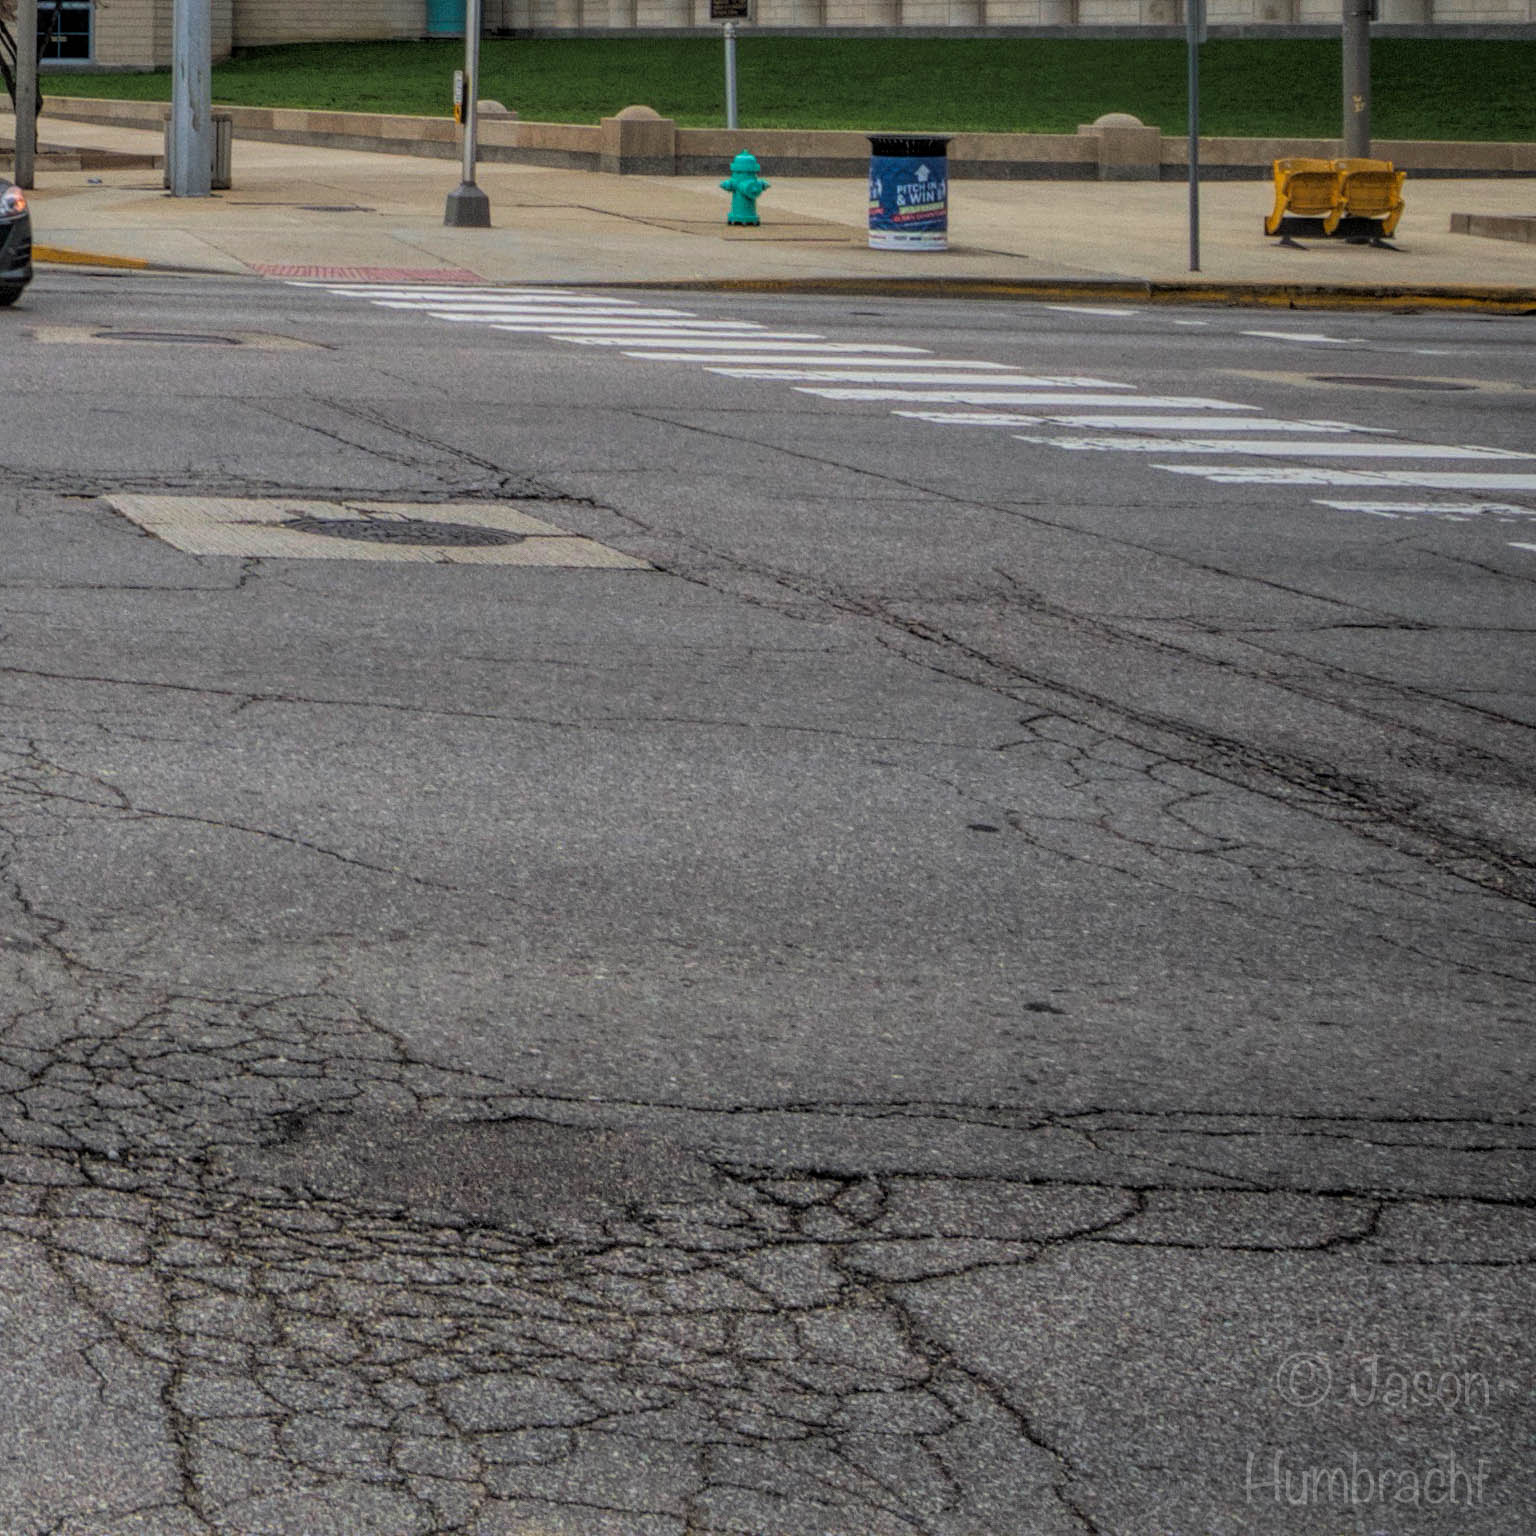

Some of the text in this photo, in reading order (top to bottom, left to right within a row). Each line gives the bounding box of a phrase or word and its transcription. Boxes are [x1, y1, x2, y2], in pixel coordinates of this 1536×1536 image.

[897, 182, 926, 195] PITCH
[896, 190, 935, 206] & WIN
